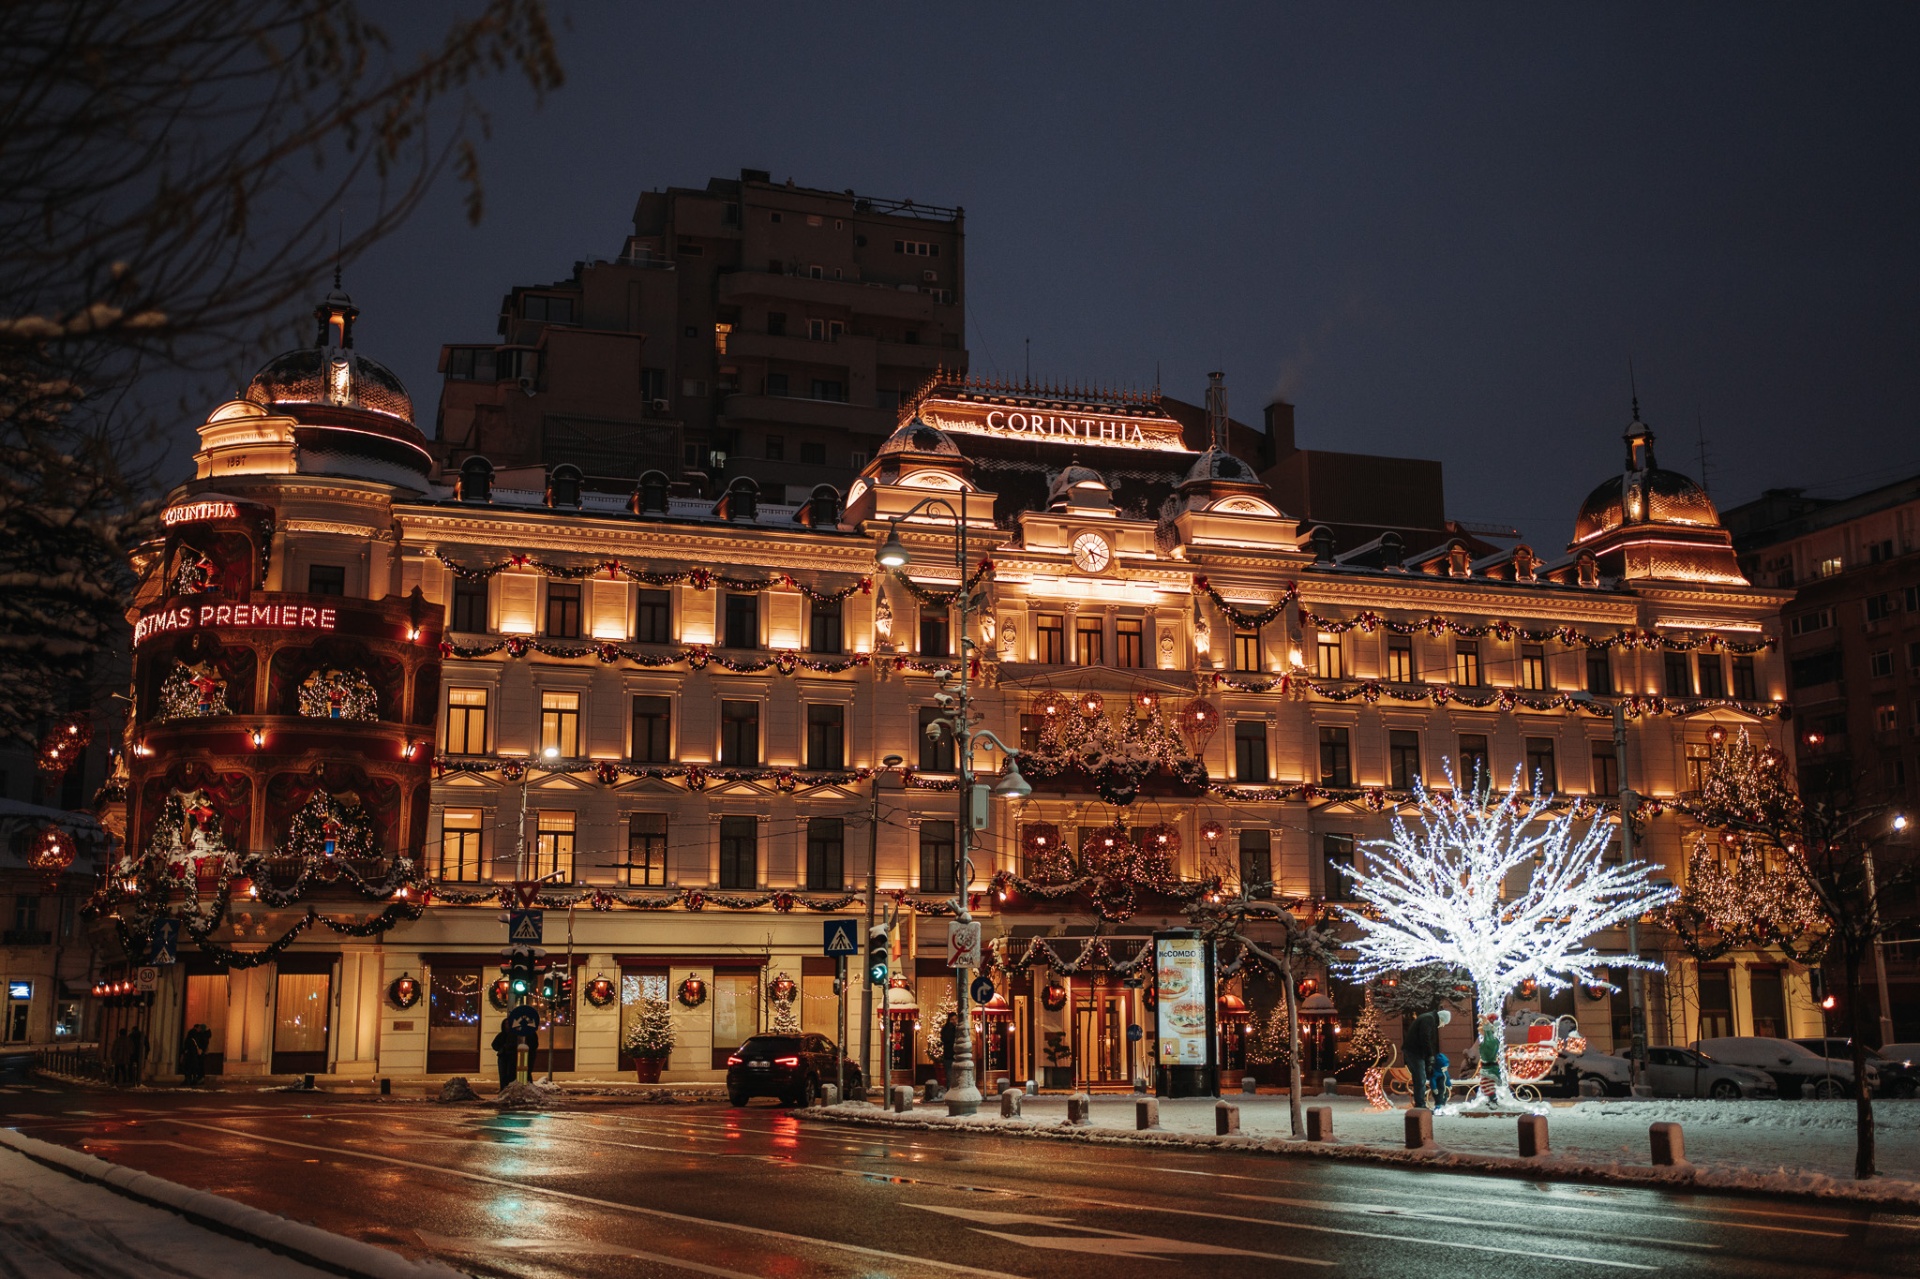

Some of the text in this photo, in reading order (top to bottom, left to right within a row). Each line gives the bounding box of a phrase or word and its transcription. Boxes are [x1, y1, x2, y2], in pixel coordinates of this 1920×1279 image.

[987, 411, 1145, 442] CORINTHIA
[200, 605, 336, 628] PREMIERE
[142, 971, 153, 979] 30
